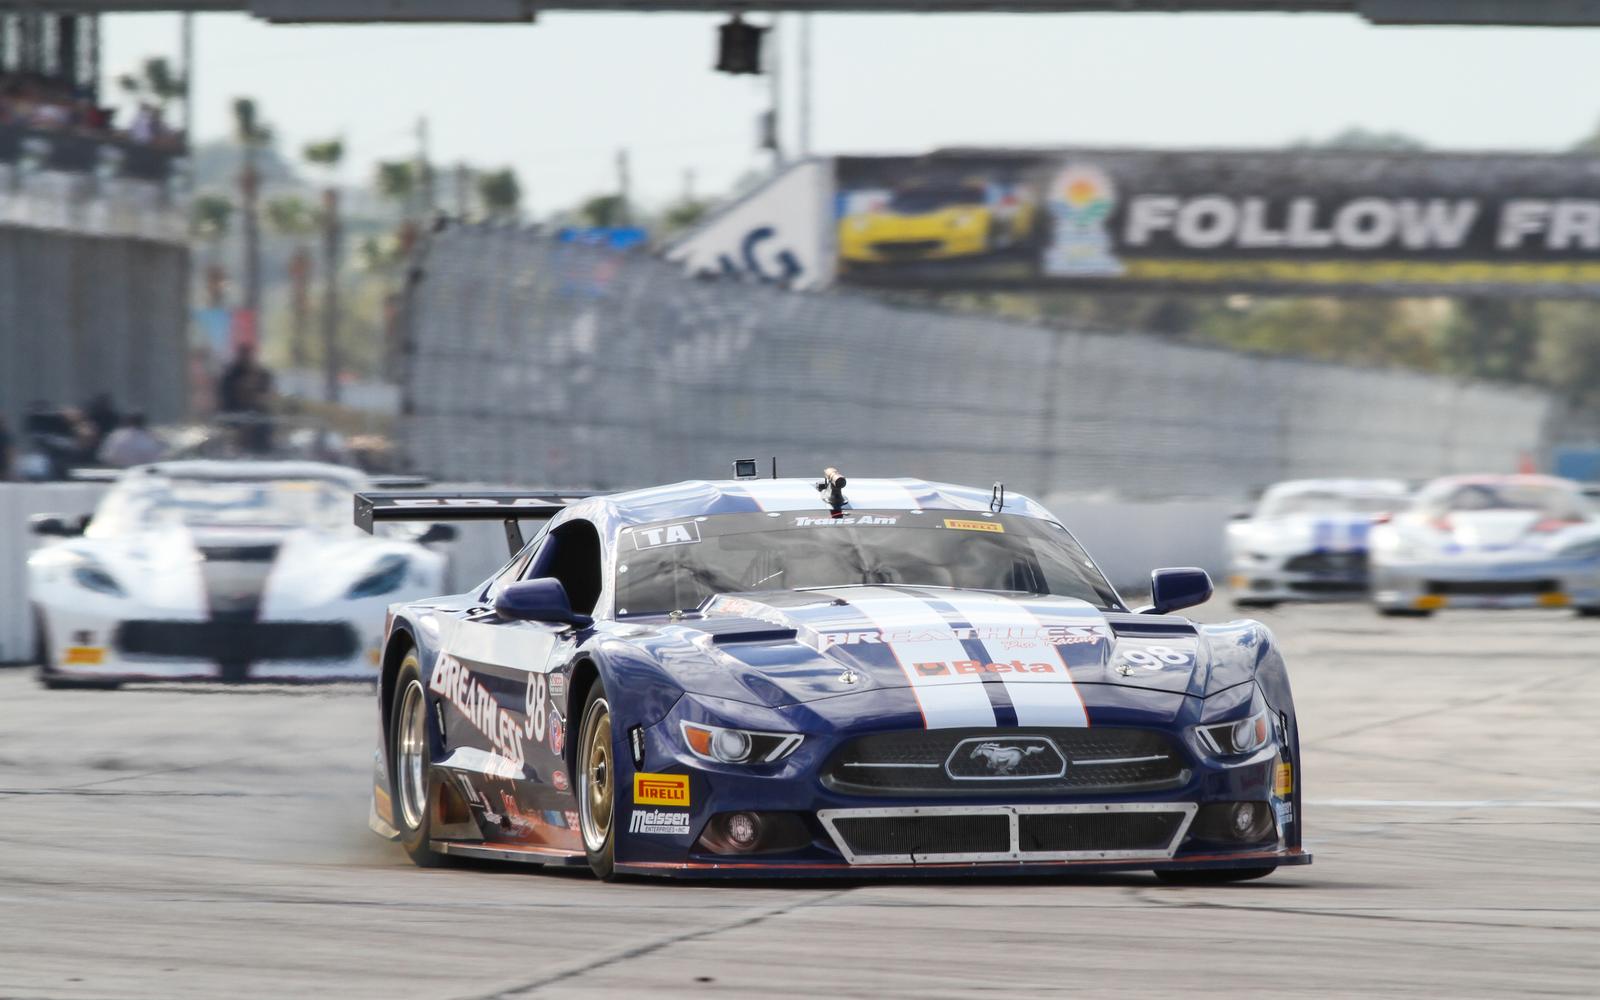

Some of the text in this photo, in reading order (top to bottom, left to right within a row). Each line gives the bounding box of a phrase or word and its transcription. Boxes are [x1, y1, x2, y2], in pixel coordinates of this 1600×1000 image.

[1124, 193, 1478, 250] FOLLOW
[794, 514, 897, 527] Trans Am
[641, 524, 693, 546] TA
[818, 625, 1106, 648] BREATHLESS
[952, 659, 1056, 675] Beta
[1122, 644, 1190, 671] 98
[429, 648, 525, 772] BREATHLESS
[524, 671, 546, 743] 98
[638, 779, 685, 800] PIRELLI
[629, 809, 690, 834] Meissen
